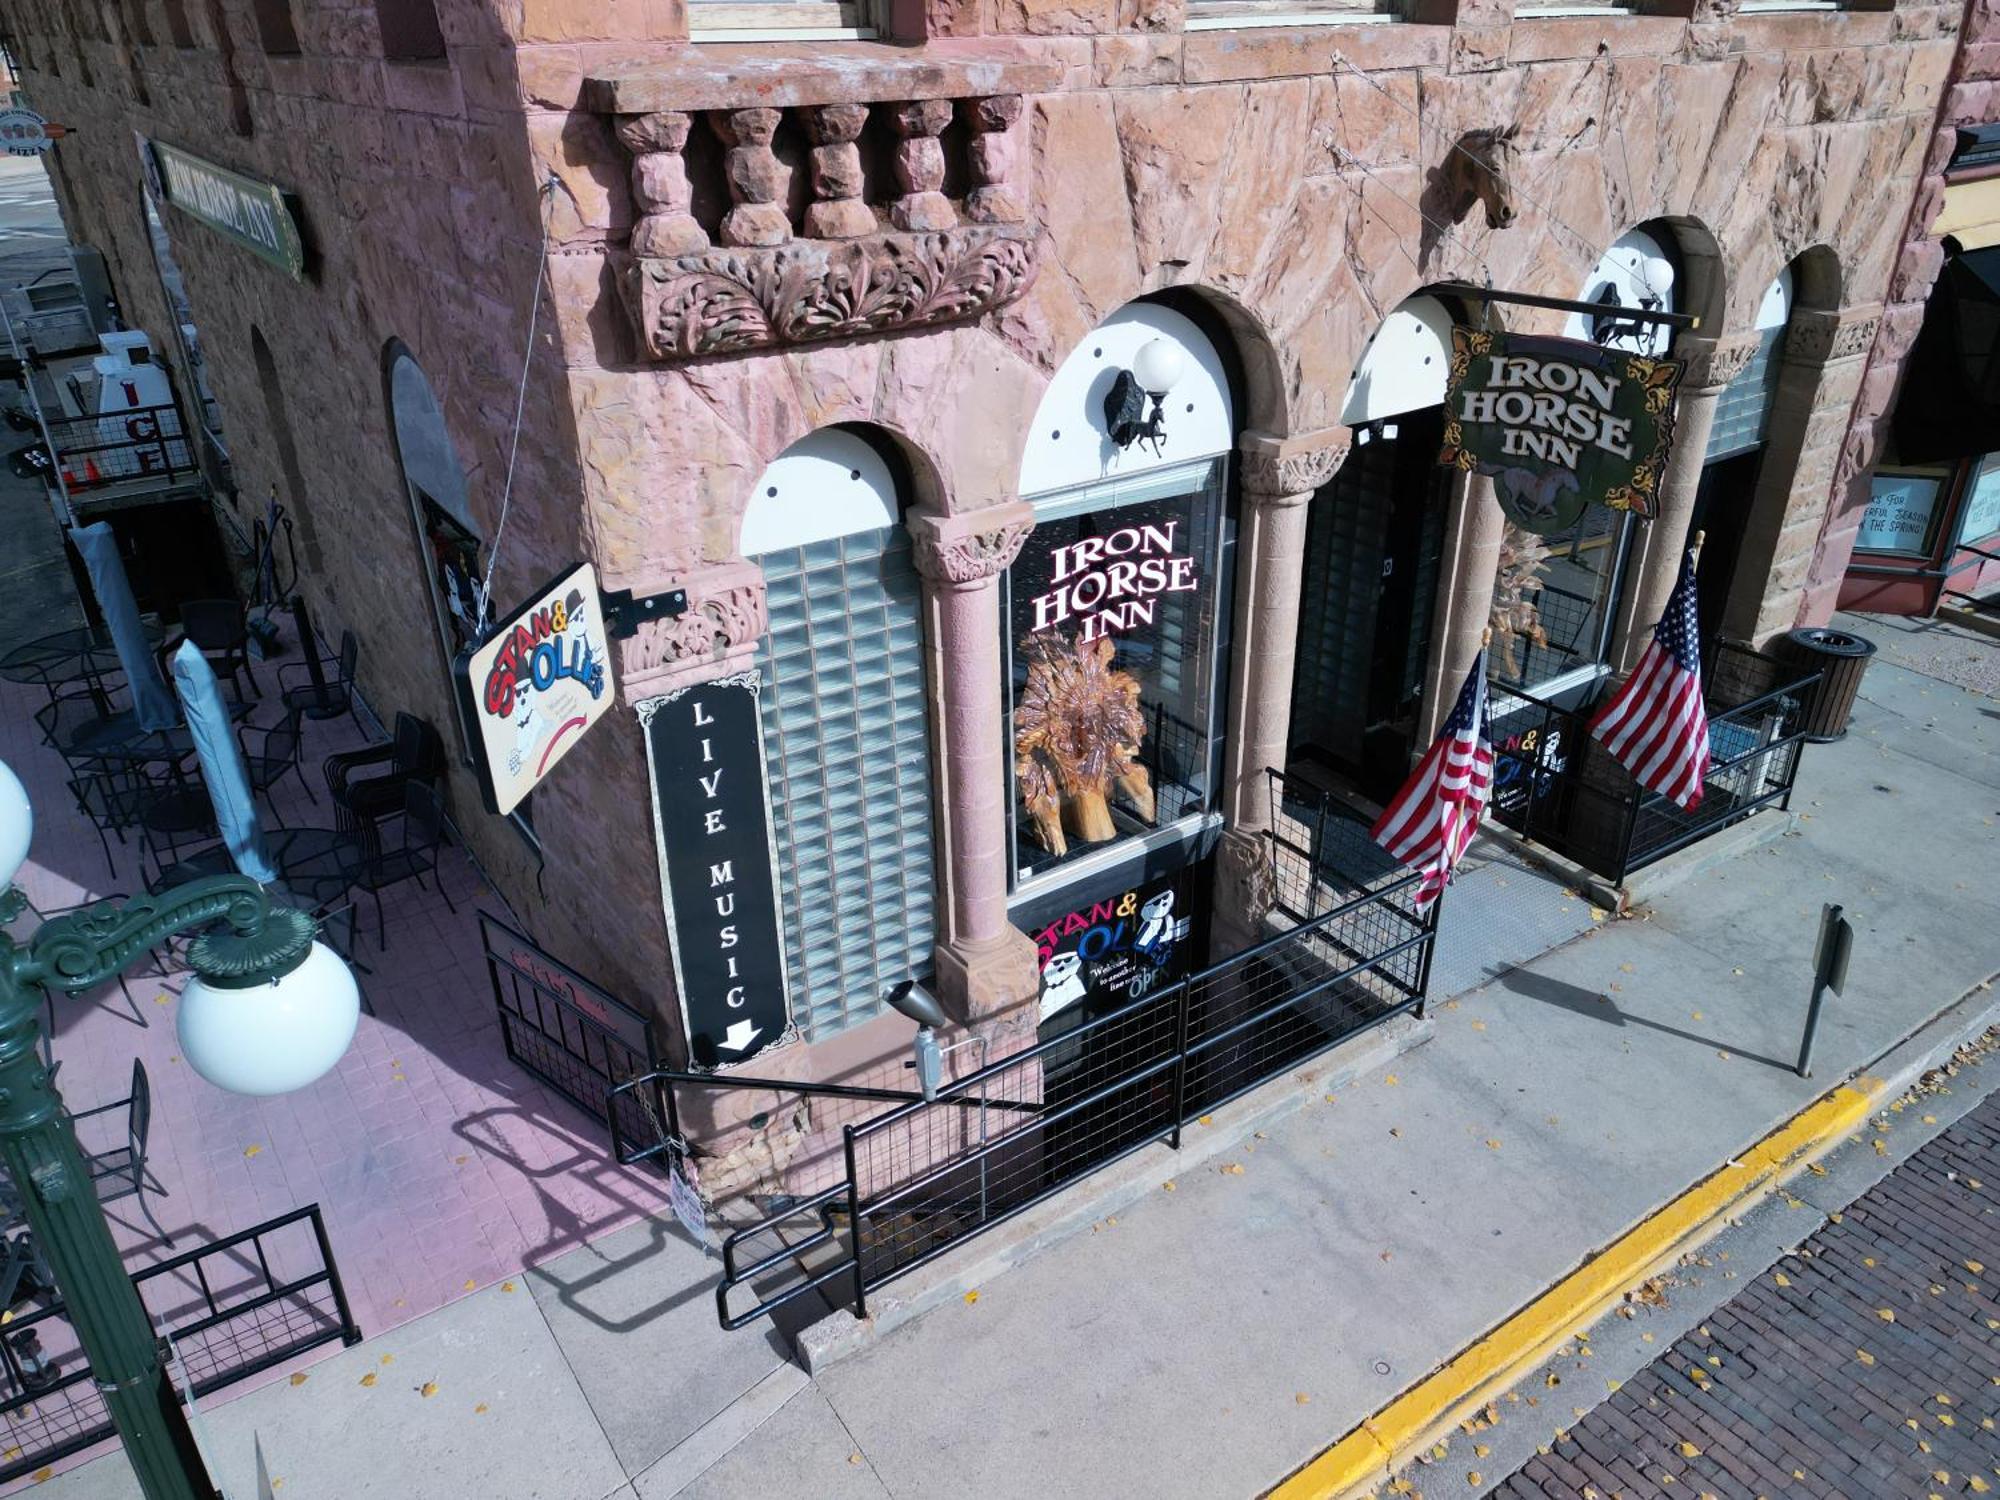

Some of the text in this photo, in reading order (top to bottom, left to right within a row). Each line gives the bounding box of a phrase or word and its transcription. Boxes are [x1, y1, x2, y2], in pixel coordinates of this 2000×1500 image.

[240, 191, 280, 252] INN
[1486, 355, 1621, 411] IRON
[1460, 390, 1633, 461] HORSE
[1501, 427, 1583, 470] INN
[1050, 520, 1178, 585] IRON
[1030, 556, 1198, 633] HORSE
[1080, 598, 1157, 646] INN
[484, 607, 552, 719] STAN
[693, 702, 746, 1009] LIVE MUSIC
